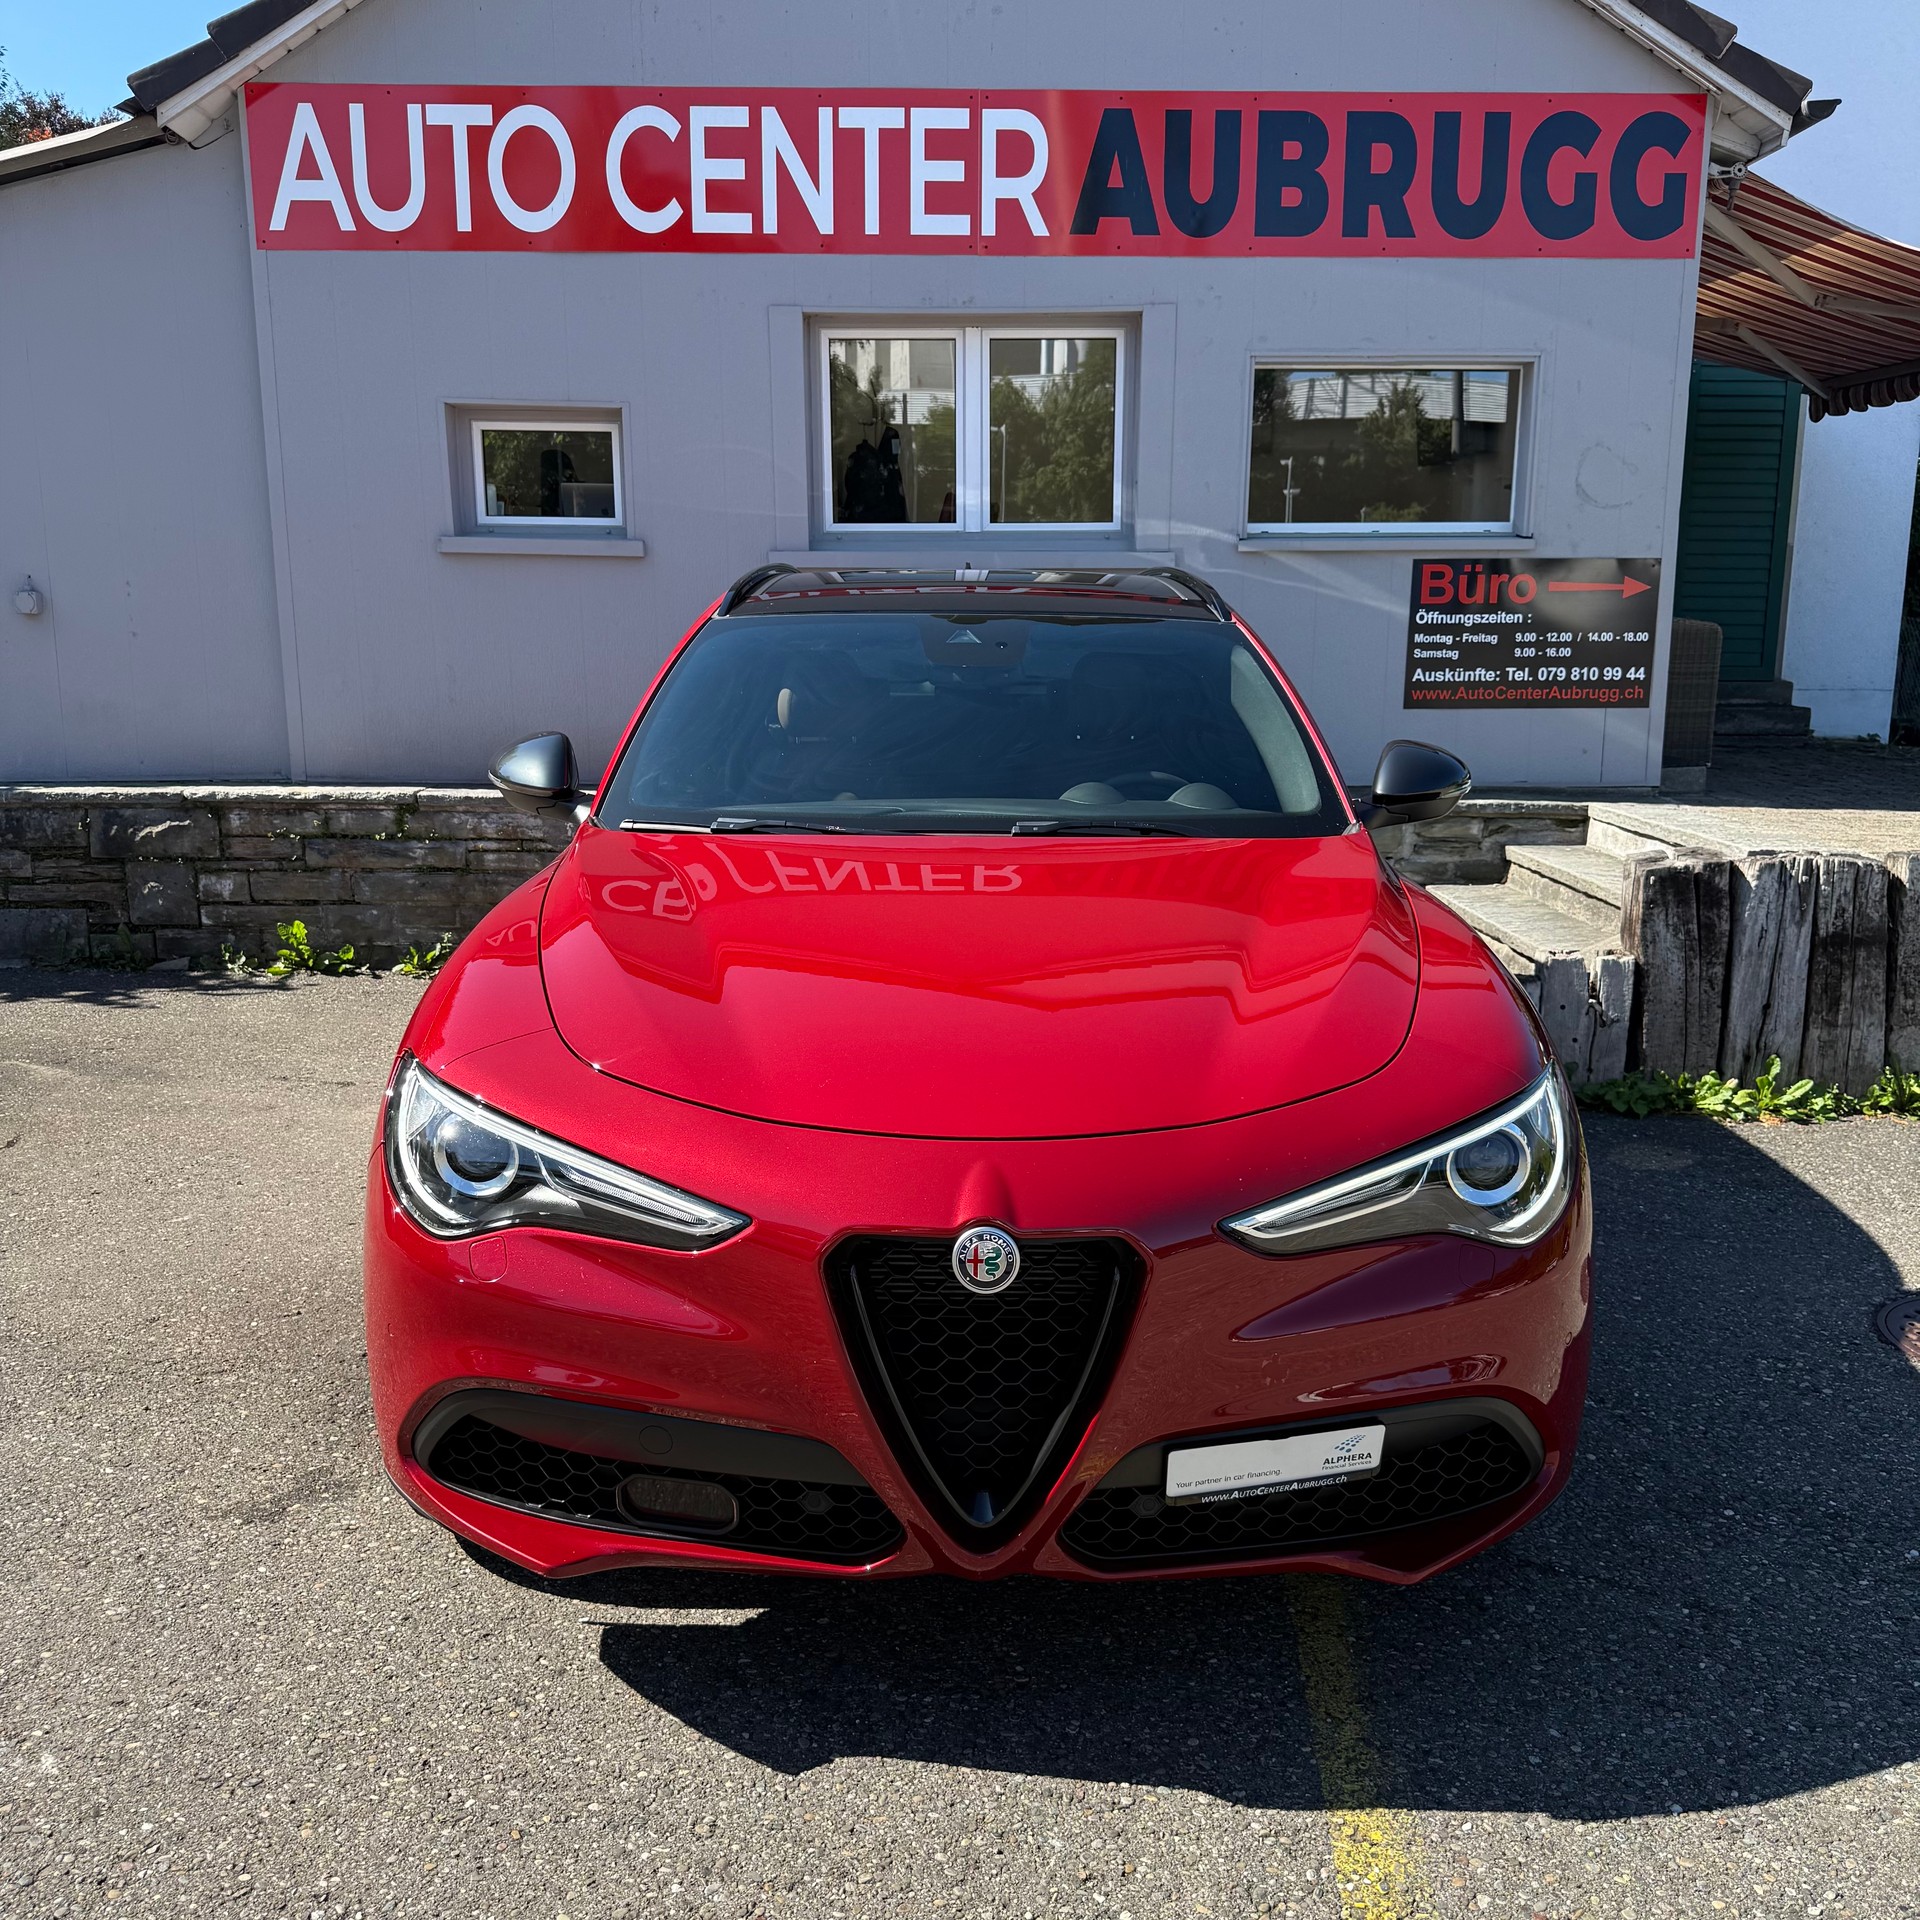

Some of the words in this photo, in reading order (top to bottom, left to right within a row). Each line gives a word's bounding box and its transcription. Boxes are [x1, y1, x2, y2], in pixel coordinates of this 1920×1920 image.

[269, 102, 577, 234] AUTO
[605, 105, 1051, 238] CENTER
[1069, 107, 1693, 242] AUBRUGG
[1420, 564, 1538, 605] Büro
[1415, 609, 1523, 627] Öffnungszeiten
[1414, 633, 1453, 645] Montag
[1462, 633, 1499, 645] Freitag
[1515, 632, 1537, 642] 9.00
[1546, 632, 1573, 642] 12.00
[1587, 632, 1614, 642] 14.00
[1622, 632, 1649, 642] 18.00
[1413, 648, 1459, 660] Samstag
[1514, 647, 1536, 658] 9.00
[1545, 647, 1572, 657] 16.00
[1412, 667, 1501, 682] Auskünfte:
[1505, 667, 1533, 682] Tel.
[1537, 667, 1566, 681] 079
[1570, 667, 1599, 681] 810
[1603, 667, 1622, 681] 99
[1626, 666, 1646, 681] 44
[1411, 685, 1644, 702] www.AutoCenterAubrugg.ch
[960, 1237, 979, 1262] ALFA
[983, 1234, 1014, 1262] ROMEO
[1321, 1463, 1347, 1471] Financial
[1347, 1460, 1372, 1468] Services
[1323, 1452, 1373, 1466] ALPHERA
[1175, 1481, 1194, 1489] Your
[1194, 1477, 1223, 1488] partner
[1247, 1468, 1283, 1479] financing.
